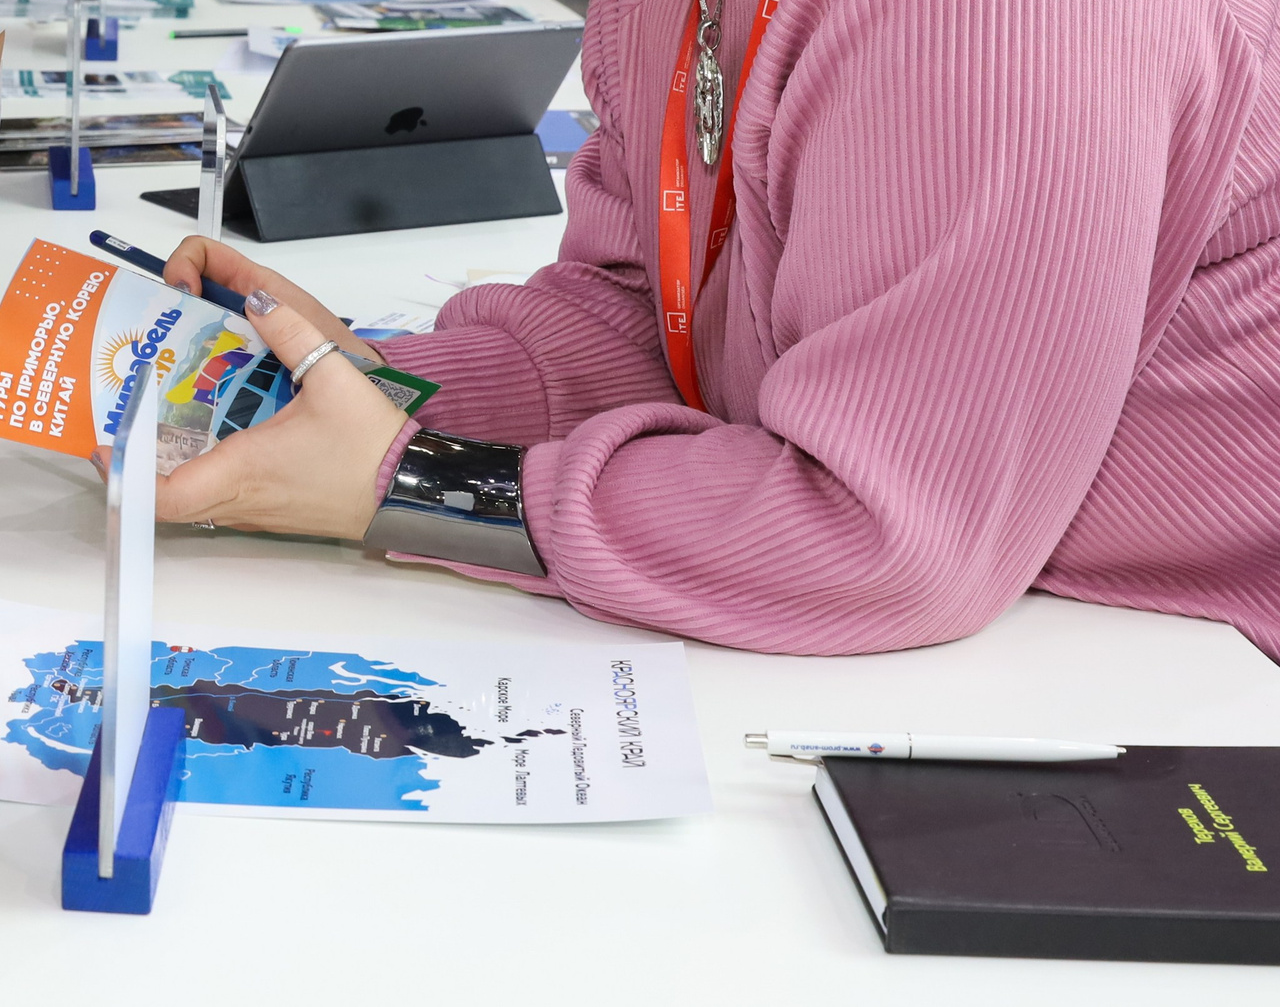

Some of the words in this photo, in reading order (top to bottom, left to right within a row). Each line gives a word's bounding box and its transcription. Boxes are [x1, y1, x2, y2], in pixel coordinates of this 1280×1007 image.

[66, 270, 110, 322] КОРЕЮ,
[16, 300, 67, 398] ПРИМОРЬЮ,
[33, 322, 75, 416] СЕВЕРНУЮ
[103, 308, 183, 437] Мирабель
[9, 400, 27, 429] ПО
[48, 375, 77, 438] КИТАЙ
[29, 419, 44, 434] В
[181, 657, 196, 678] Томская
[494, 677, 512, 705] Карское
[611, 659, 643, 738] КРАСНОЯРСКИЙ
[494, 705, 512, 724] Море
[567, 707, 587, 742] Северный
[511, 748, 529, 768] Море
[570, 742, 591, 782] Ледовитый
[619, 740, 647, 769] КРАЙ
[300, 768, 316, 801] Республика
[515, 770, 531, 807] Лаптевых
[575, 782, 591, 806] Океан
[1187, 783, 1235, 831] Сергеевич
[1218, 831, 1269, 872] Валерий
